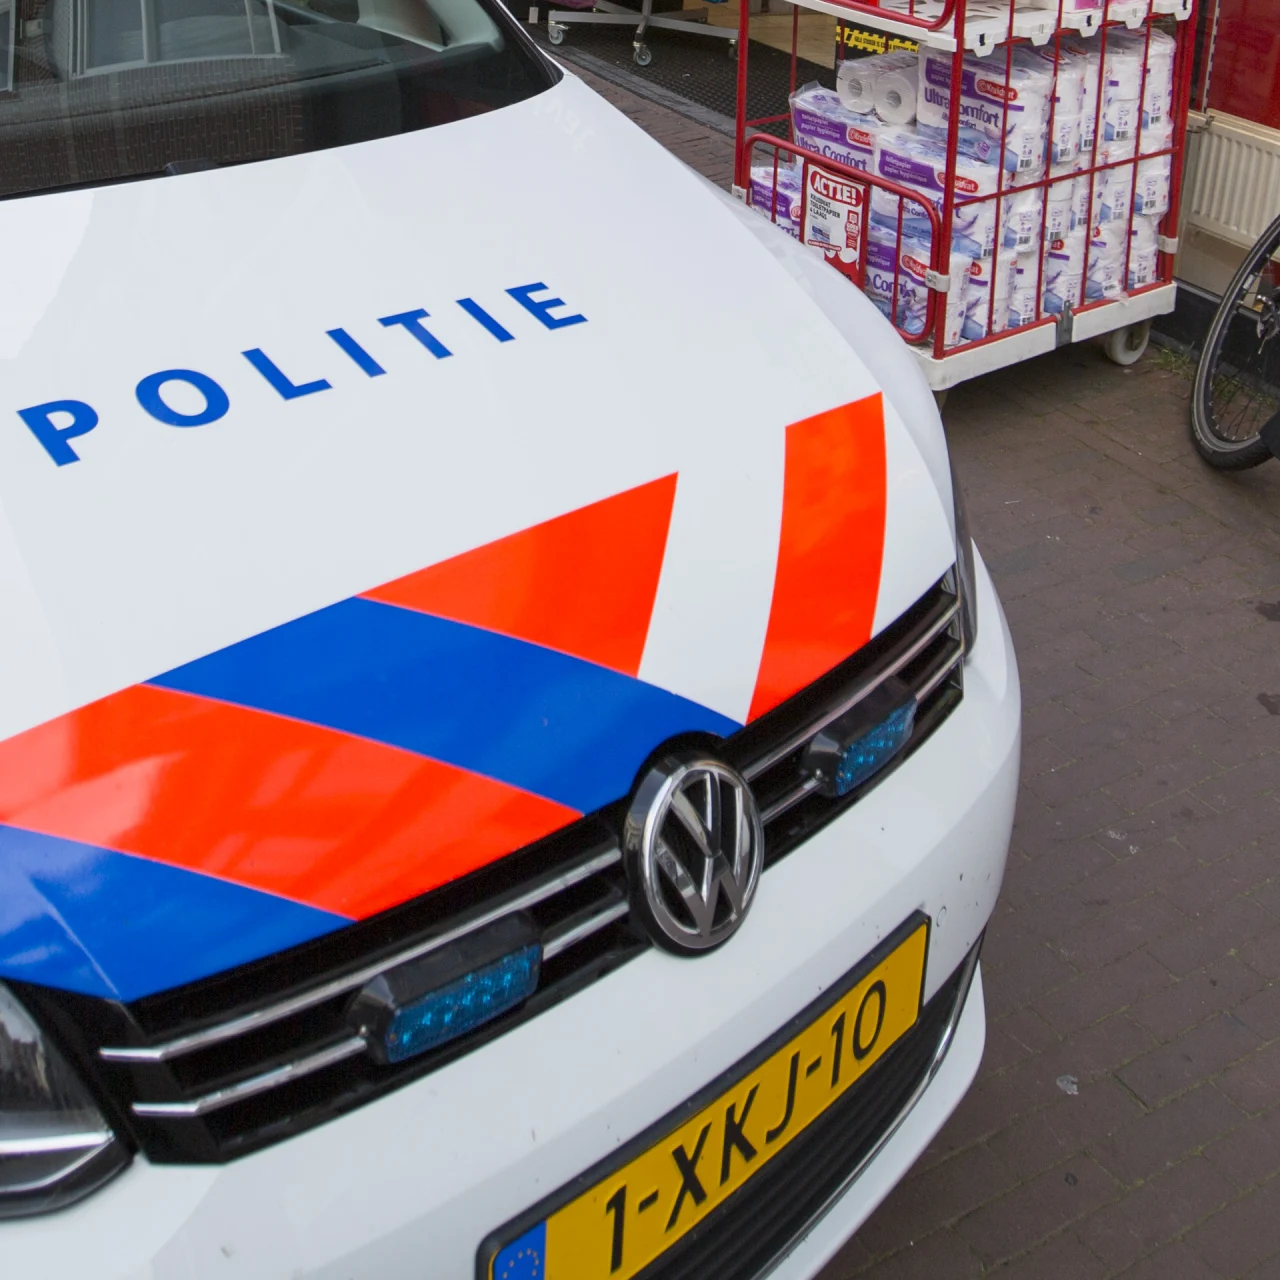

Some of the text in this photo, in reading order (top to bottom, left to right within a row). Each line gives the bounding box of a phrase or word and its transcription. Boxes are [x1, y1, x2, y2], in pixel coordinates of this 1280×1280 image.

[822, 145, 868, 171] Comfort
[810, 193, 831, 208] KRUIDVAT
[814, 173, 857, 205] ACTIE!
[810, 200, 841, 219] TOILETPAPIER
[17, 281, 589, 467] POLITIE
[605, 980, 886, 1274] 1-XKJ-10
